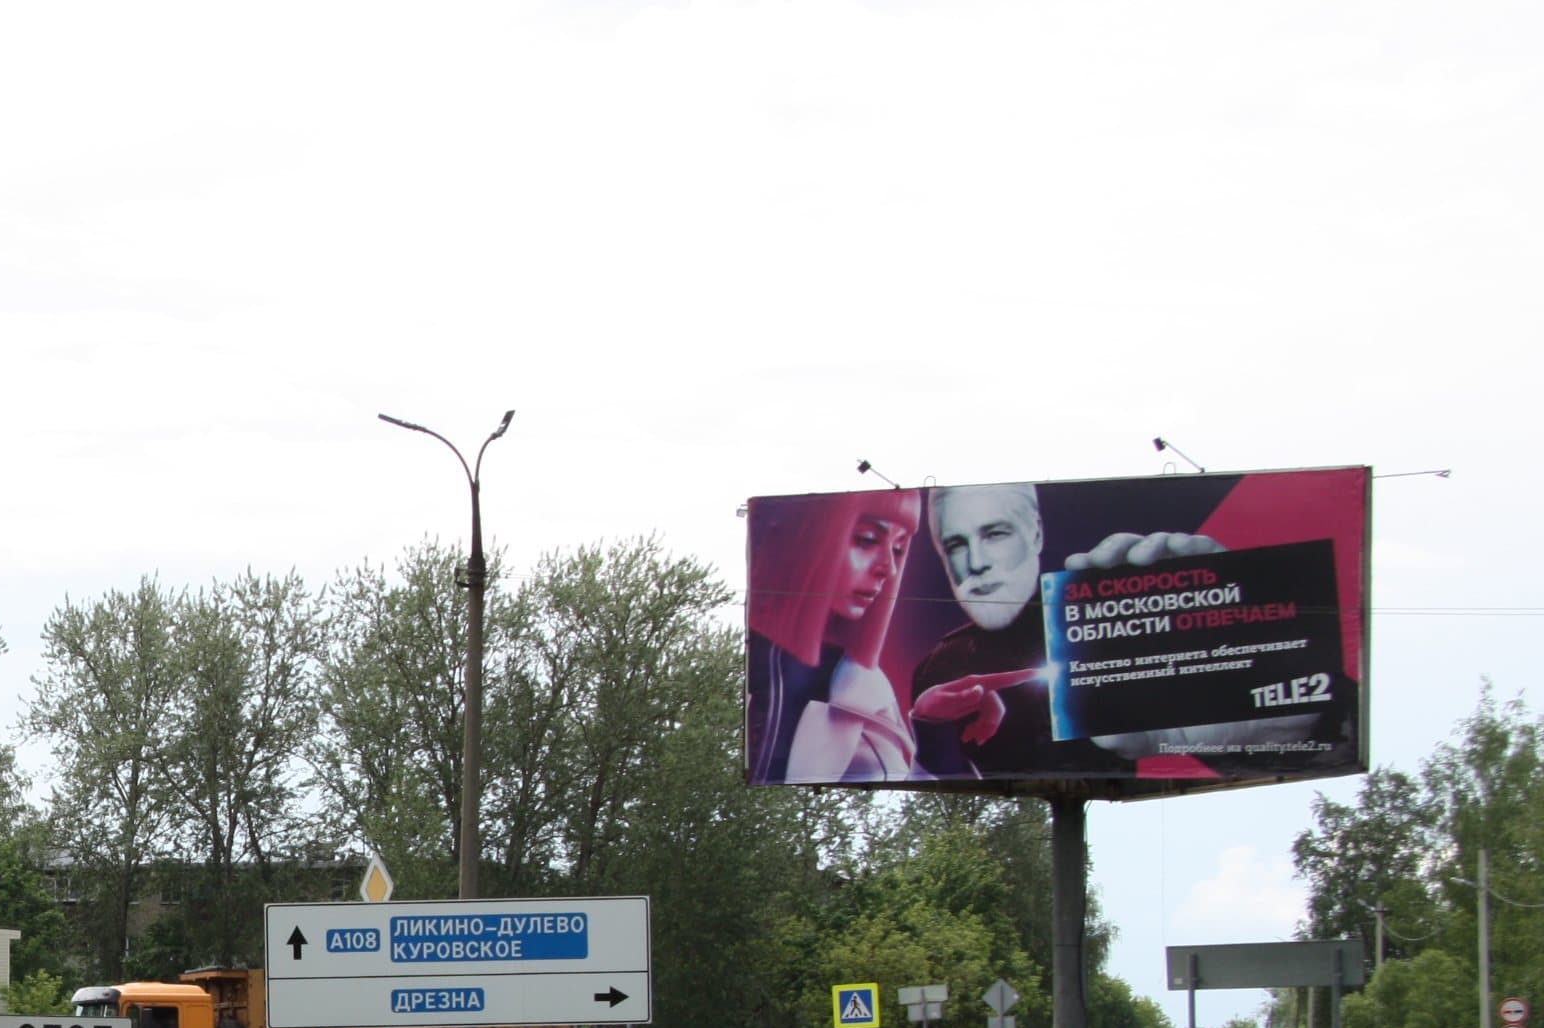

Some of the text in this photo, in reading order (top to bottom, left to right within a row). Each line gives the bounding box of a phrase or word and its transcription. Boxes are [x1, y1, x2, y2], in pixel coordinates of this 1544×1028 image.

[1065, 568, 1218, 600] ЗА СКОРОСТЬ
[1065, 583, 1240, 622] В МОСКОВСКОЙ
[1066, 602, 1297, 643] ОБЛАСТИ ОТВЕЧАЕМ
[1070, 639, 1308, 673] Качество интернета обеспечивает
[1071, 659, 1253, 687] искусственный интеллект
[1250, 672, 1332, 707] TELE2
[1159, 740, 1332, 755] Подробнее на quality.tele2.ru
[393, 916, 585, 937] ЛИКИНО-ДУЛЕВО
[393, 940, 523, 960] КУРОВСКОЕ
[394, 991, 481, 1012] ДРЕЗНА
